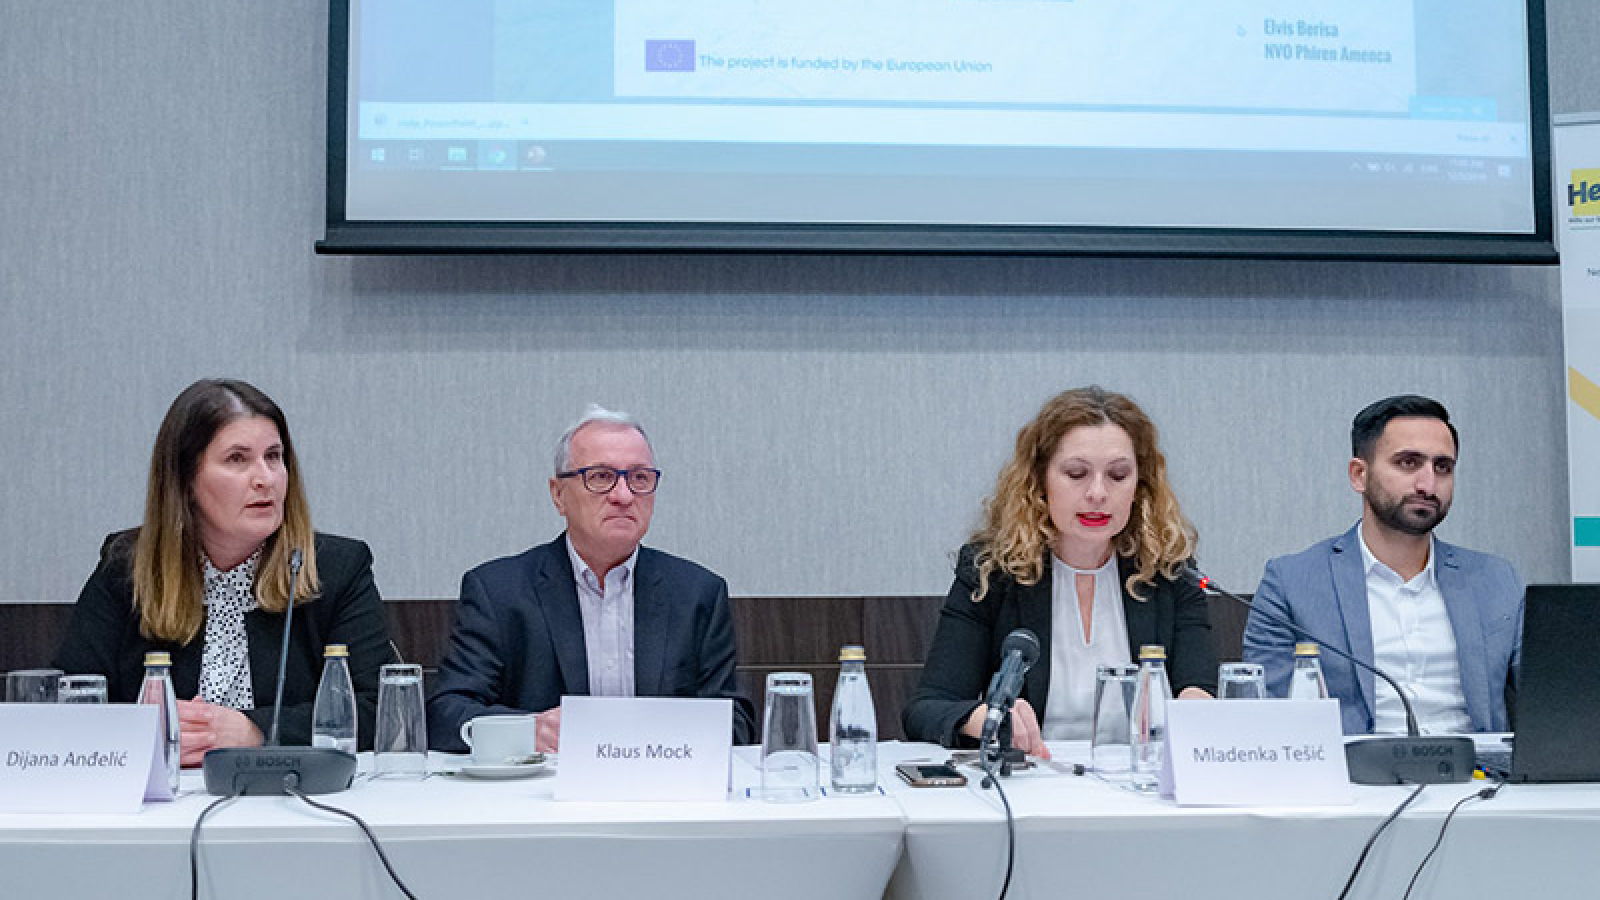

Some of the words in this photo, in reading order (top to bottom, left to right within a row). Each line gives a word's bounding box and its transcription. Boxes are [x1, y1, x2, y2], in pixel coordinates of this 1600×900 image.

[1263, 18, 1294, 36] Elvis
[1296, 20, 1339, 38] Berisa
[1263, 43, 1293, 60] NVO
[1295, 44, 1337, 61] Phiren
[699, 55, 725, 68] The
[727, 56, 774, 70] project
[777, 57, 788, 69] is
[791, 56, 839, 71] funded
[842, 58, 859, 72] by
[861, 58, 884, 71] the
[886, 59, 951, 74] European
[953, 60, 993, 73] Union
[6, 751, 59, 770] Dijana
[63, 750, 129, 768] Anđelić
[596, 743, 640, 759] Klaus
[645, 743, 693, 759] Mock
[1193, 747, 1278, 763] Mladenka
[1282, 745, 1326, 762] Tešić
[1411, 745, 1454, 757] BOSCH
[256, 755, 301, 767] BOSCH
